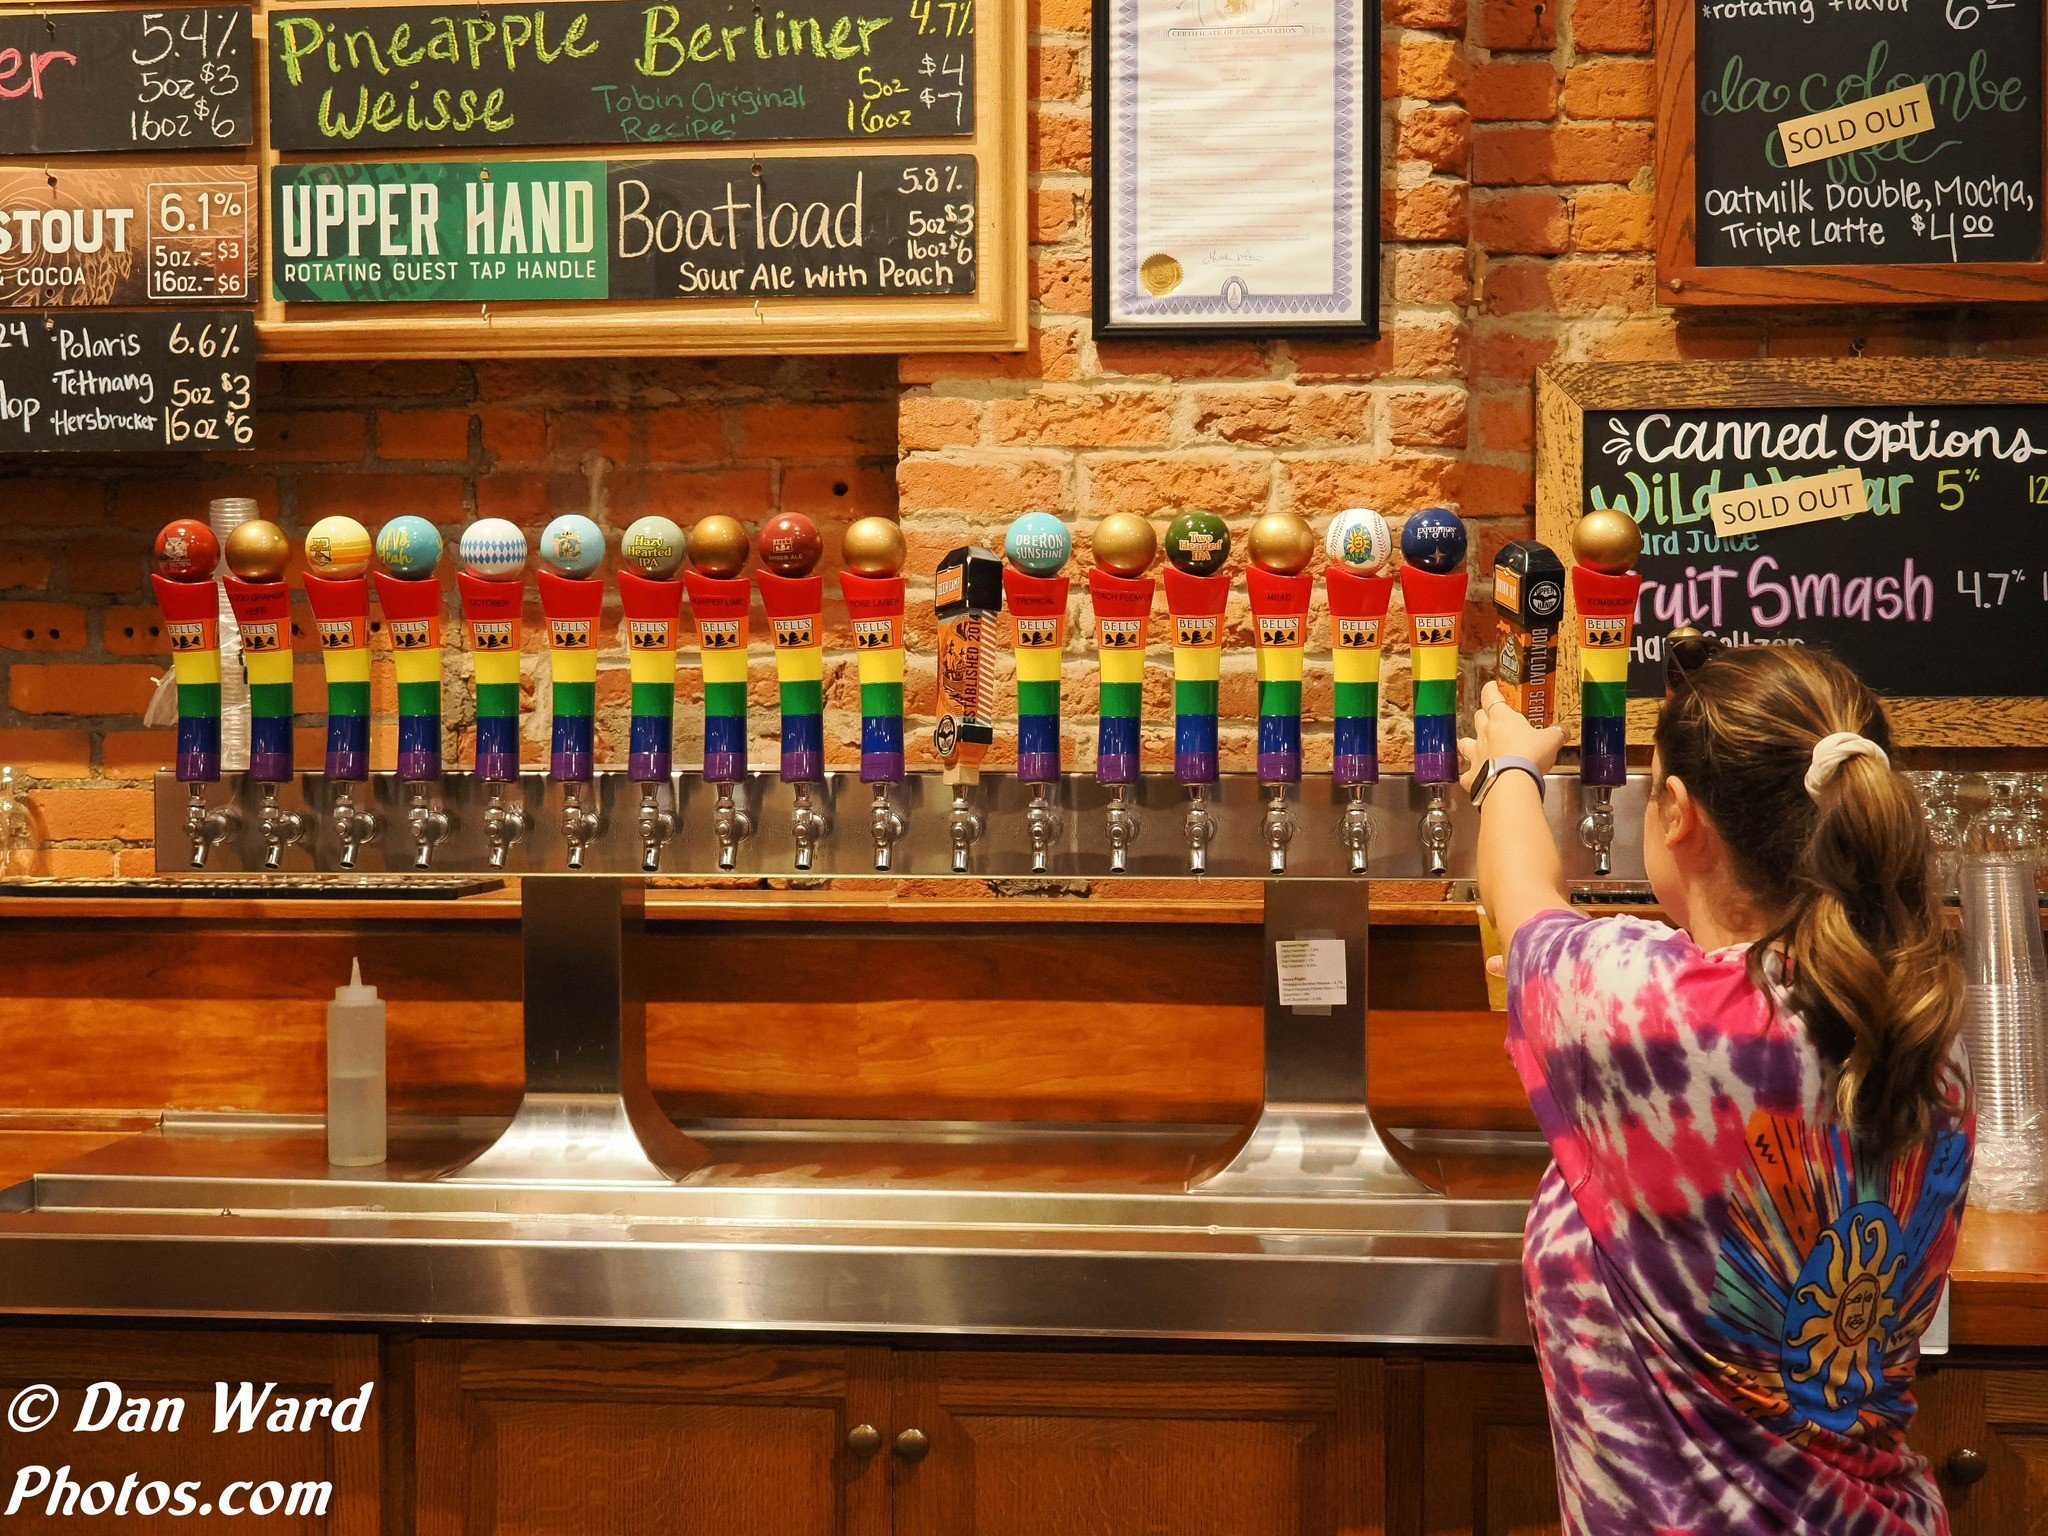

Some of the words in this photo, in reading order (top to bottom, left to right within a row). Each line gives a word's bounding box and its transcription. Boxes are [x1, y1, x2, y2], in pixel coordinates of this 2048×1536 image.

[132, 10, 238, 65] 5.4%
[1236, 28, 1297, 36] PROCLAMATION
[275, 10, 599, 86] Pineapple
[634, 4, 894, 77] Berliner
[317, 81, 515, 140] Weisse
[591, 84, 683, 114] Tobin
[692, 82, 805, 115] Original
[858, 66, 910, 101] 5oz
[918, 53, 964, 86] $4
[847, 99, 912, 133] 16oz
[1788, 118, 1857, 155] SOLD
[1865, 100, 1921, 134] OUT
[1934, 175, 2033, 211] Mocha,
[161, 192, 242, 232] 6.1%
[282, 184, 439, 257] UPPER
[466, 181, 594, 255] HAND
[618, 171, 863, 258] Boatload
[898, 166, 962, 194] 5.8%
[0, 209, 134, 254] STOUT
[1721, 222, 1801, 254] Triple
[1811, 217, 1885, 247] Latte
[17, 266, 86, 286] COCOA
[285, 263, 381, 282] ROTATING
[393, 261, 459, 281] GUEST
[470, 261, 506, 280] TAP
[517, 259, 596, 279] HANDLE
[679, 261, 747, 292] Sour
[751, 263, 795, 290] Ale
[879, 257, 953, 288] Peach
[60, 327, 141, 361] Polaris
[169, 322, 240, 358] 6.6%
[54, 368, 154, 404] Tettnang
[54, 407, 158, 436] Hersbrucker
[1636, 413, 1837, 464] Canned
[1844, 411, 2047, 463] Options
[1937, 468, 1981, 511] 5%
[1722, 494, 1789, 526] SOLD
[1799, 483, 1853, 512] OUT
[635, 535, 663, 548] Hazy
[1016, 533, 1063, 549] OBERON
[1179, 539, 1223, 551] Hearted
[1189, 532, 1213, 543] Two
[1640, 531, 1680, 556] ard
[1686, 530, 1760, 553] Juice
[627, 546, 672, 557] Hearted
[1016, 547, 1063, 559] SUNSHINE
[1192, 551, 1211, 561] IPA
[638, 558, 659, 567] IPA
[1632, 564, 1739, 628] ruit
[1747, 556, 1933, 627] Smash
[1957, 569, 2026, 609] 4.7%
[169, 625, 201, 634] BELL'S
[242, 625, 276, 634] BELL'S
[319, 623, 351, 632] BELL'S
[393, 622, 427, 632] BELL'S
[475, 624, 510, 633] BELL'S
[554, 622, 588, 632] BELL'S
[632, 623, 667, 632] BELL'S
[703, 622, 738, 632] BELL'S
[776, 620, 811, 630] BELL'S
[856, 622, 890, 632] BELL'S
[967, 613, 981, 643] 2014
[1020, 621, 1055, 630] BELL'S
[1103, 622, 1138, 631] BELL'S
[1179, 619, 1215, 629] BELL'S
[1262, 619, 1297, 629] BELL'S
[1342, 621, 1377, 630] BELL'S
[1418, 618, 1454, 628] BELL'S
[1587, 619, 1624, 629] BELL'S
[1529, 628, 1548, 686] BOATLOAD
[963, 646, 980, 724] ESTABLISHED
